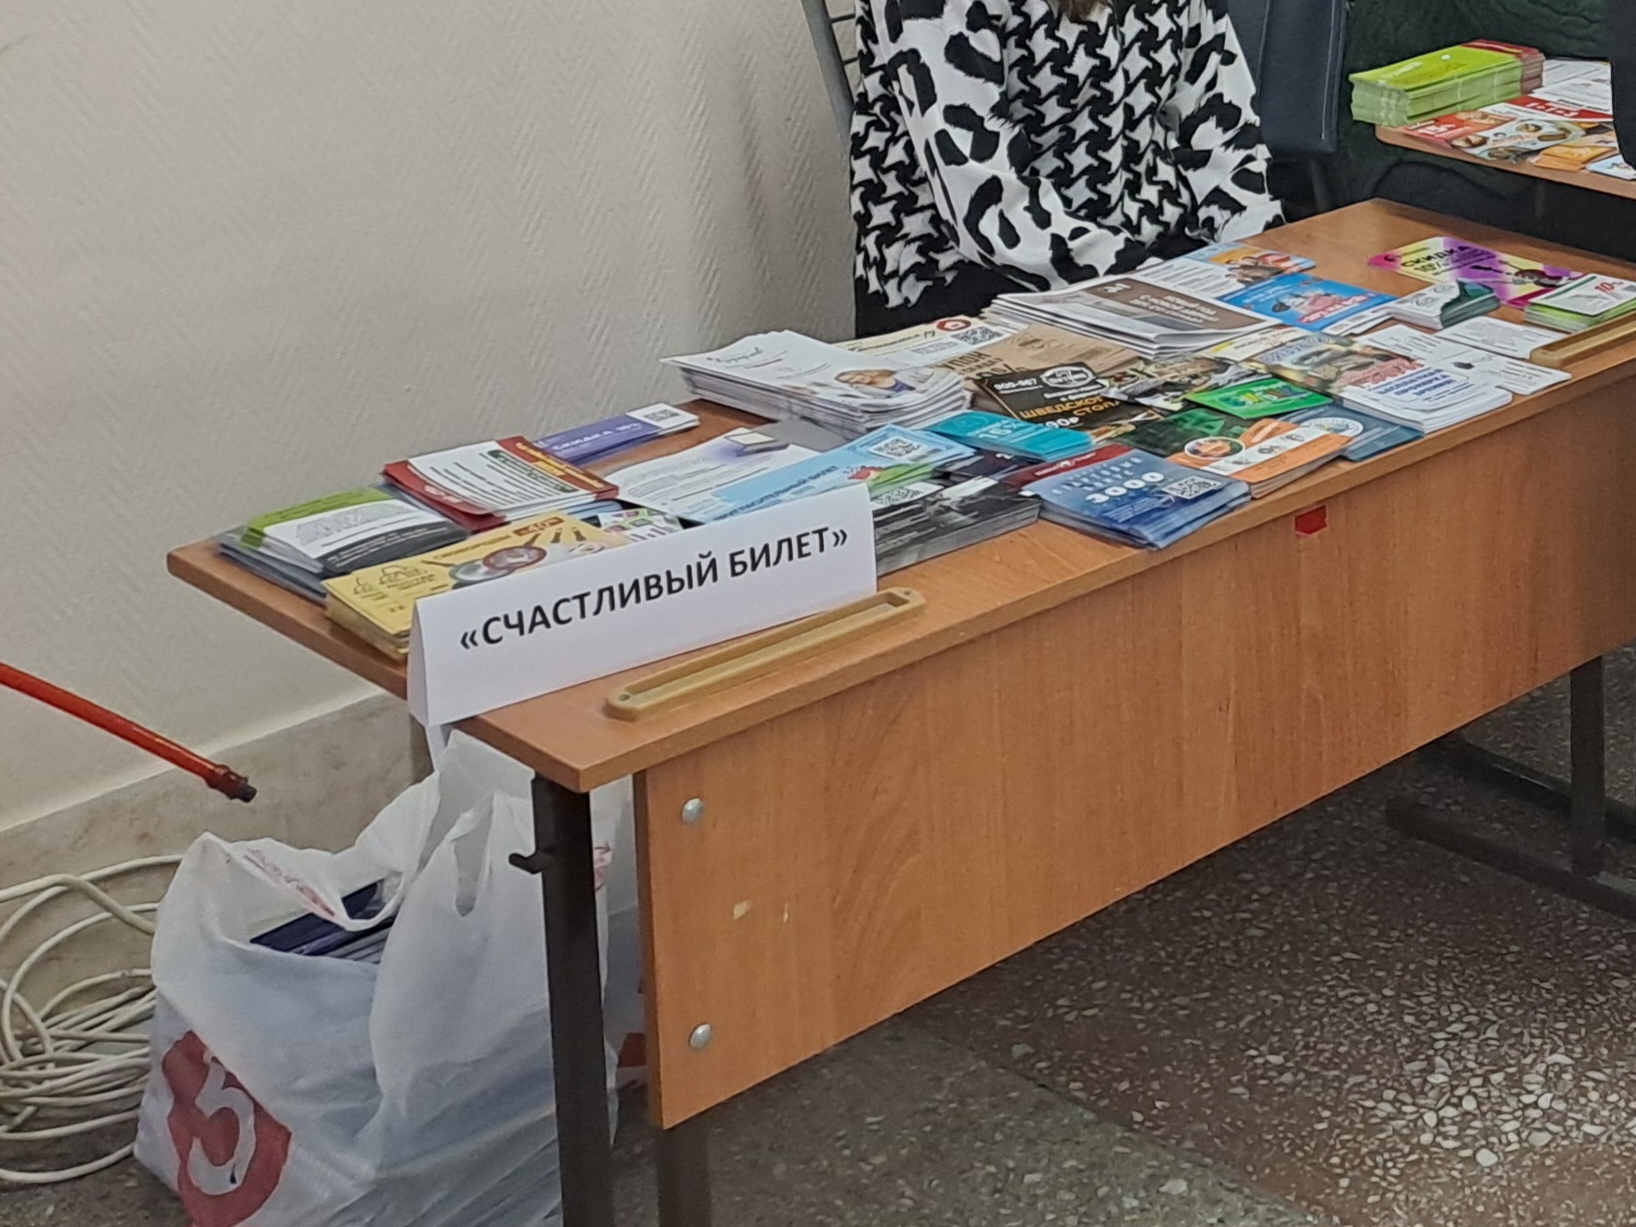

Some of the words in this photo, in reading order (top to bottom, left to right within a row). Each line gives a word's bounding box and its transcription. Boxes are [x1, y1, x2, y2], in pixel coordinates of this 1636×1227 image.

[1084, 471, 1165, 504] 3000
[460, 551, 719, 650] «СЧАСТЛИВЫЙ
[729, 526, 848, 577] БИЛЕТ»
